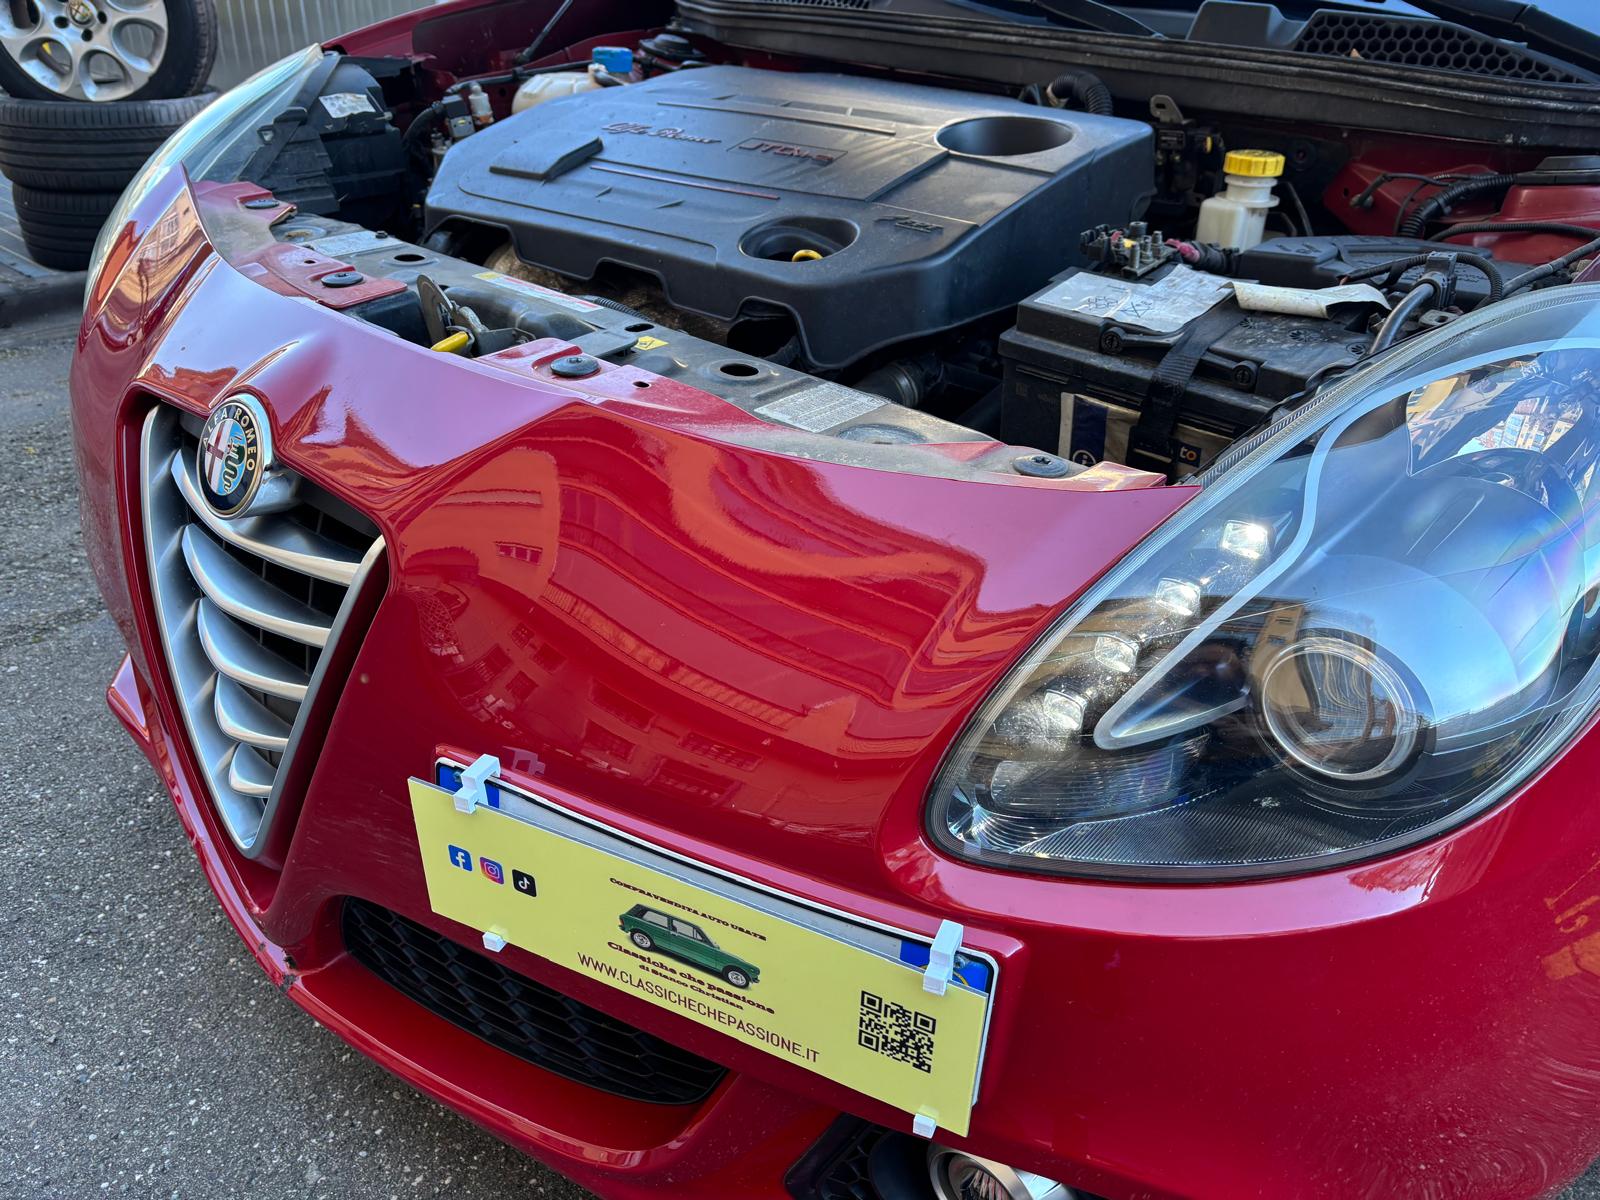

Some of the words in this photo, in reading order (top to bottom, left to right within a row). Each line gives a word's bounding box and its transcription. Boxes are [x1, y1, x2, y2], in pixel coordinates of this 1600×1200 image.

[203, 407, 228, 448] ALFA
[234, 407, 256, 471] ROMEO
[609, 877, 700, 915] COMPRAVENDITA
[700, 912, 729, 927] AUTO
[731, 923, 767, 942] USATE
[577, 951, 820, 1063] WWW.CLASSICHECHEPASSIONE.IT
[607, 941, 678, 975] Classiche
[679, 970, 706, 987] che
[706, 981, 776, 1015] passione
[638, 963, 650, 973] di
[690, 983, 744, 1011] Christian
